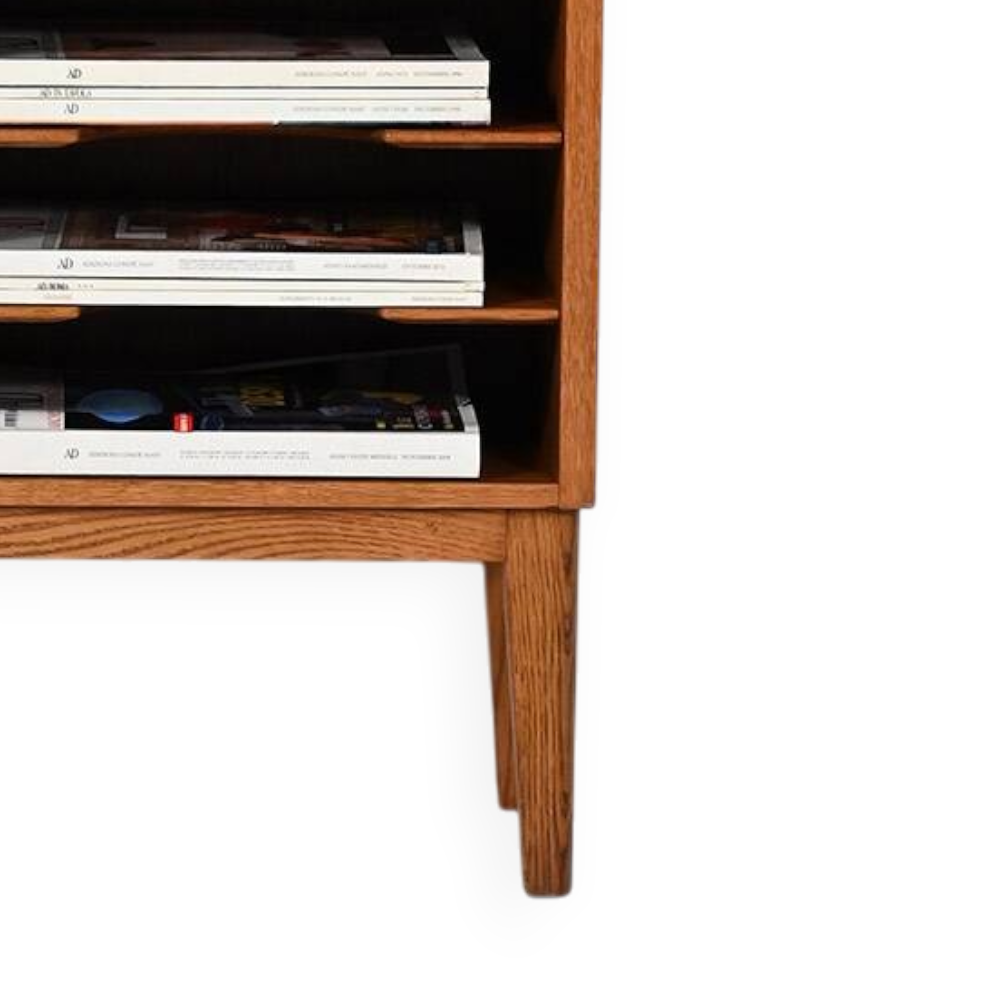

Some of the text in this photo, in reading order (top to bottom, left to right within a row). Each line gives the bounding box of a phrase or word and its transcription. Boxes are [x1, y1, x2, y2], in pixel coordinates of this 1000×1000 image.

[66, 68, 82, 80] AD
[64, 103, 80, 115] AD
[56, 257, 74, 270] AD
[63, 447, 80, 460] AD
